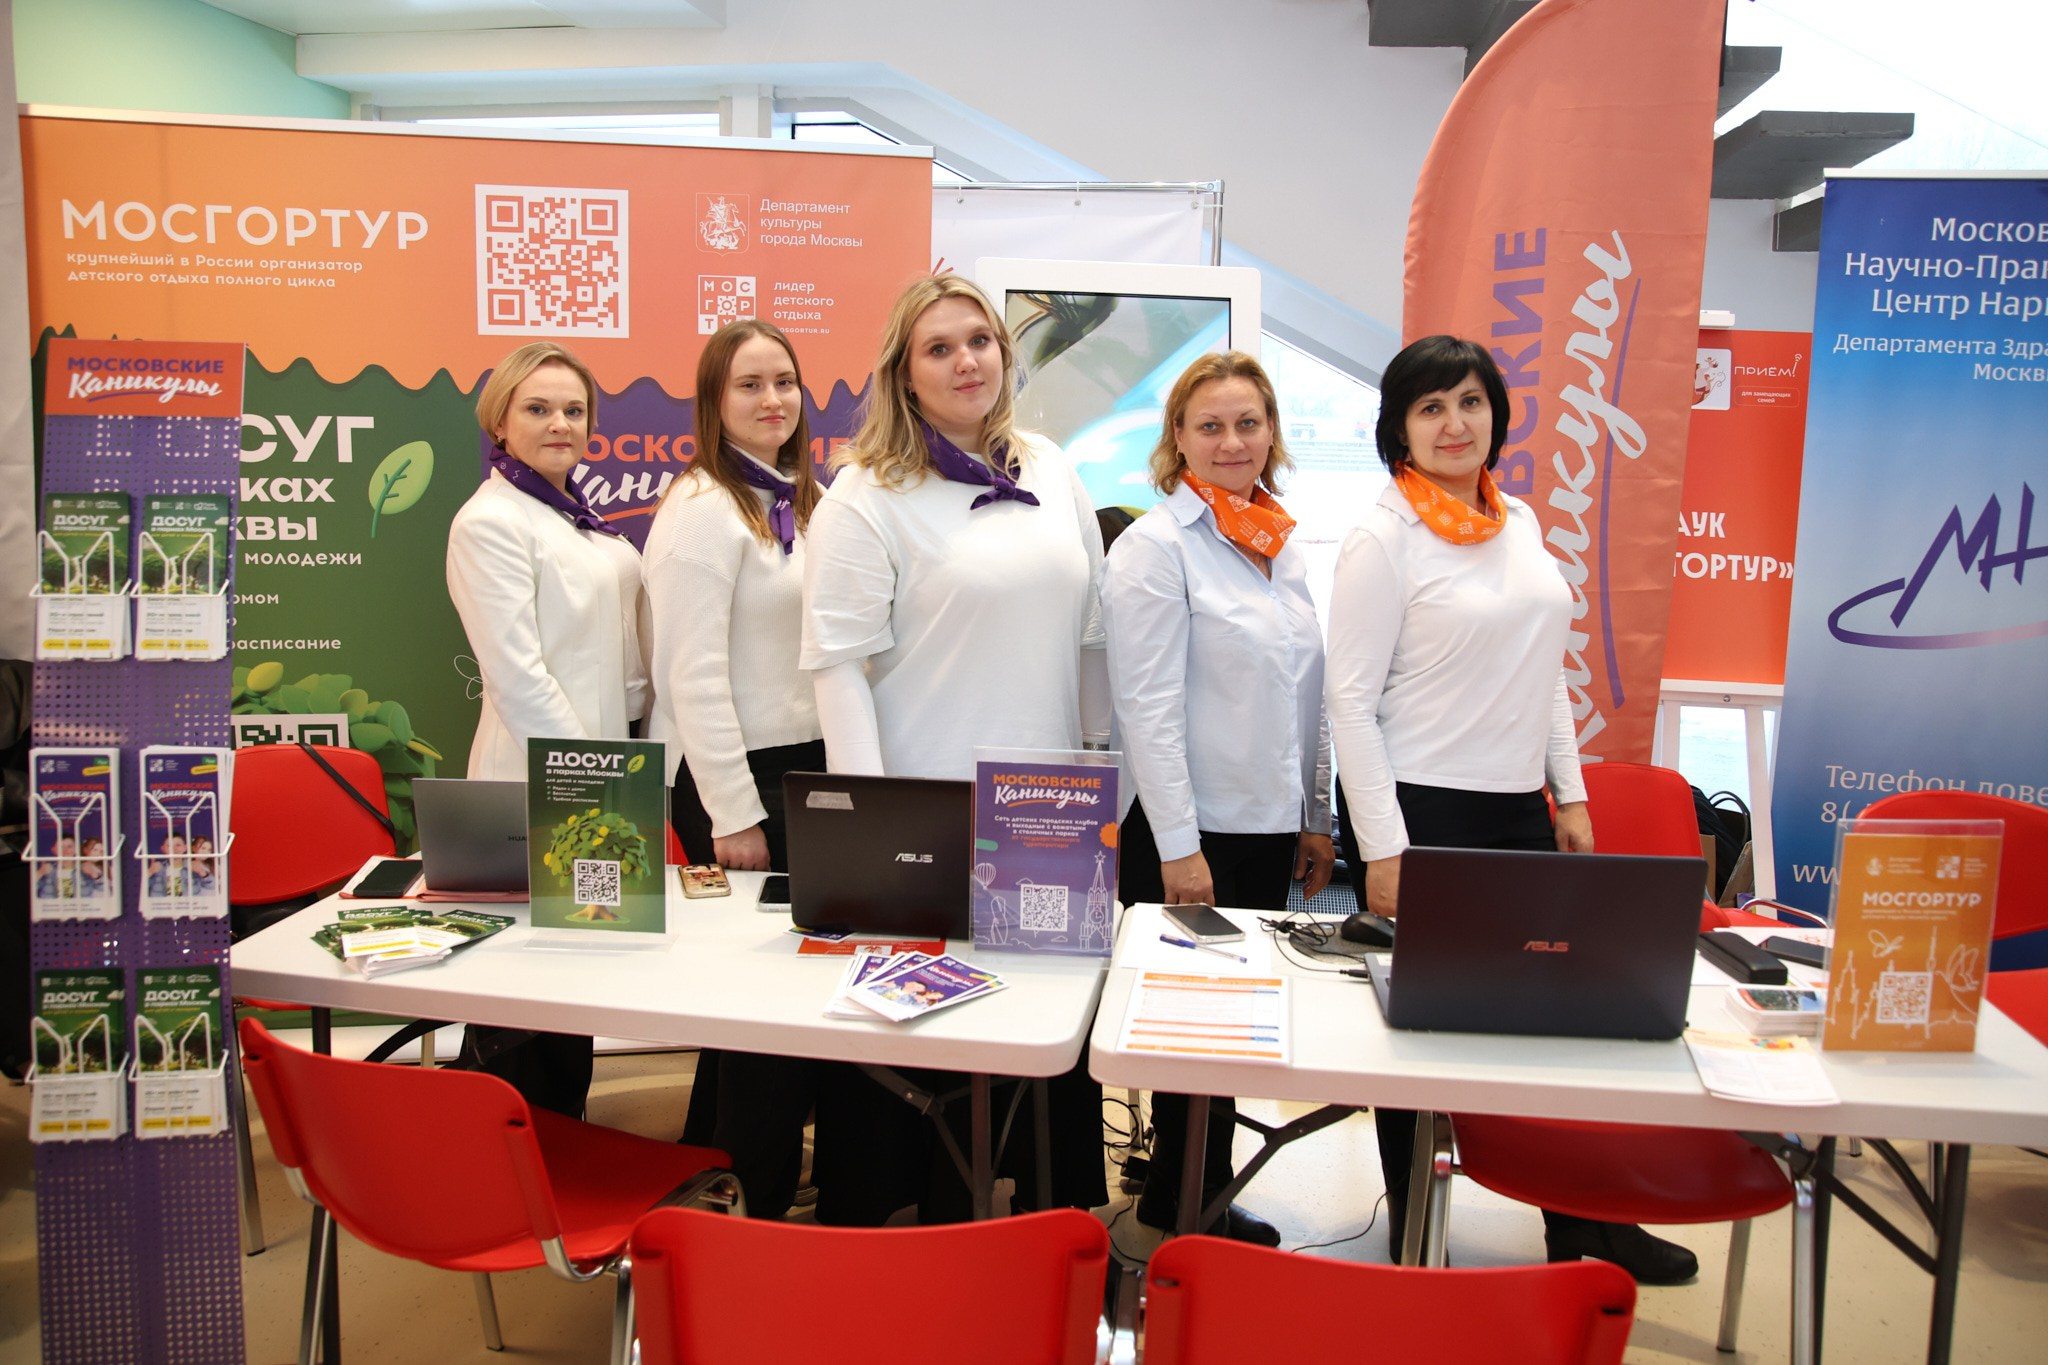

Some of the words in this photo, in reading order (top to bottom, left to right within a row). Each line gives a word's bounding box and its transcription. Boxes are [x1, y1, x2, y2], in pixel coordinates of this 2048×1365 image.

[760, 199, 851, 214] Департамент
[62, 199, 429, 249] МОСГОРТУР
[760, 217, 822, 231] культуры
[760, 234, 806, 246] города
[810, 234, 863, 247] Москвы
[66, 252, 174, 266] крупнейший
[180, 257, 190, 266] в
[196, 254, 254, 268] России
[259, 258, 363, 272] организатор
[68, 270, 143, 282] детского
[150, 273, 209, 284] отдыха
[215, 274, 281, 287] полного
[287, 276, 335, 288] цикла
[774, 282, 815, 294] лидер
[773, 296, 834, 307] детского
[1872, 289, 1970, 320] Центр
[1979, 291, 2048, 322] Нар
[773, 310, 822, 320] отдыха
[1833, 334, 1997, 356] Департамента
[67, 356, 224, 374] МОСКОВСКИЕ
[1973, 363, 2048, 382] Москв
[68, 371, 223, 403] Каникулы
[53, 515, 109, 526] ДОСУГ
[151, 516, 207, 527] ДОСУГ
[245, 553, 362, 567] молодежи
[546, 752, 624, 768] ДОСУГ
[587, 769, 624, 777] Москвы
[1825, 765, 1966, 793] Телефон
[992, 774, 1102, 789] МОСКОВСКИЕ
[994, 784, 1100, 809] Каникулы
[895, 852, 933, 863] ASUS
[1862, 891, 1982, 908] МОСГОРТУР
[1523, 941, 1569, 952] ASUS
[144, 989, 200, 1002] ДОСУГ
